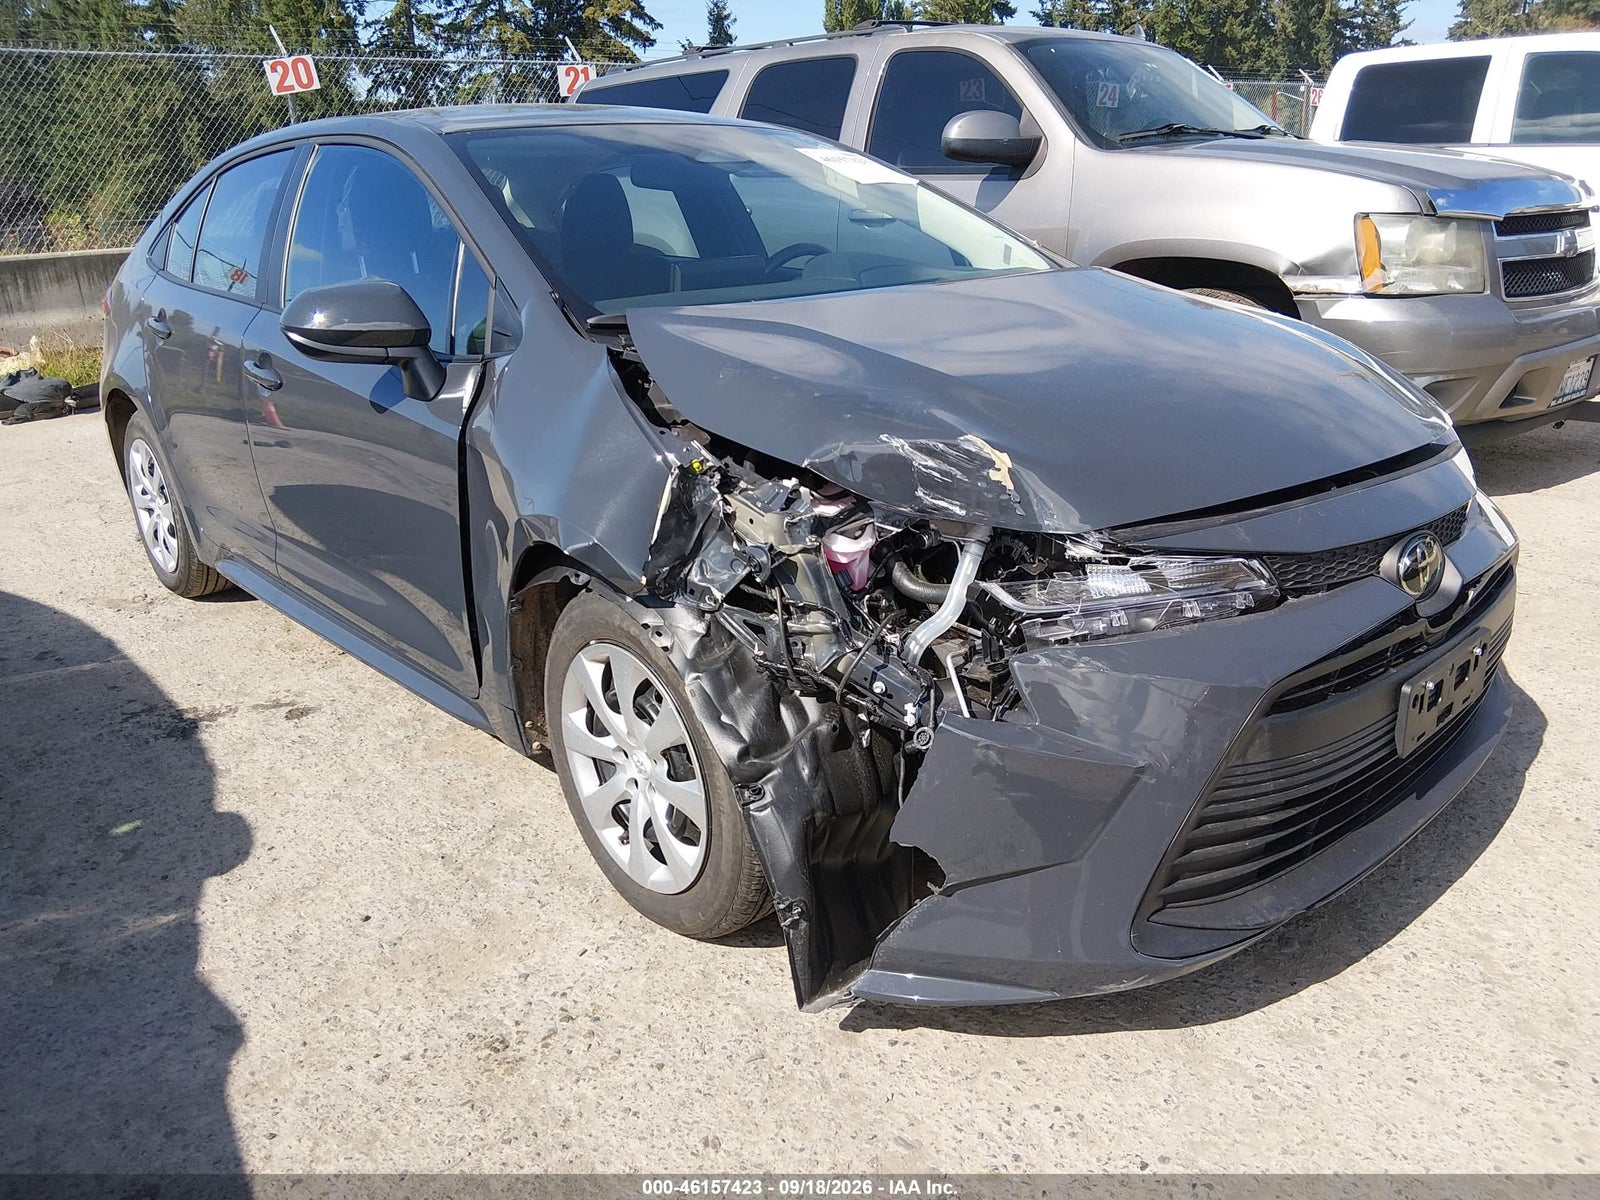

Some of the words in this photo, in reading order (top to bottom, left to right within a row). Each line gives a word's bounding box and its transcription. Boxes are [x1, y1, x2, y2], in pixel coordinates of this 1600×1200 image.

[269, 57, 315, 93] 20
[564, 66, 590, 95] 21
[1098, 83, 1118, 106] 24
